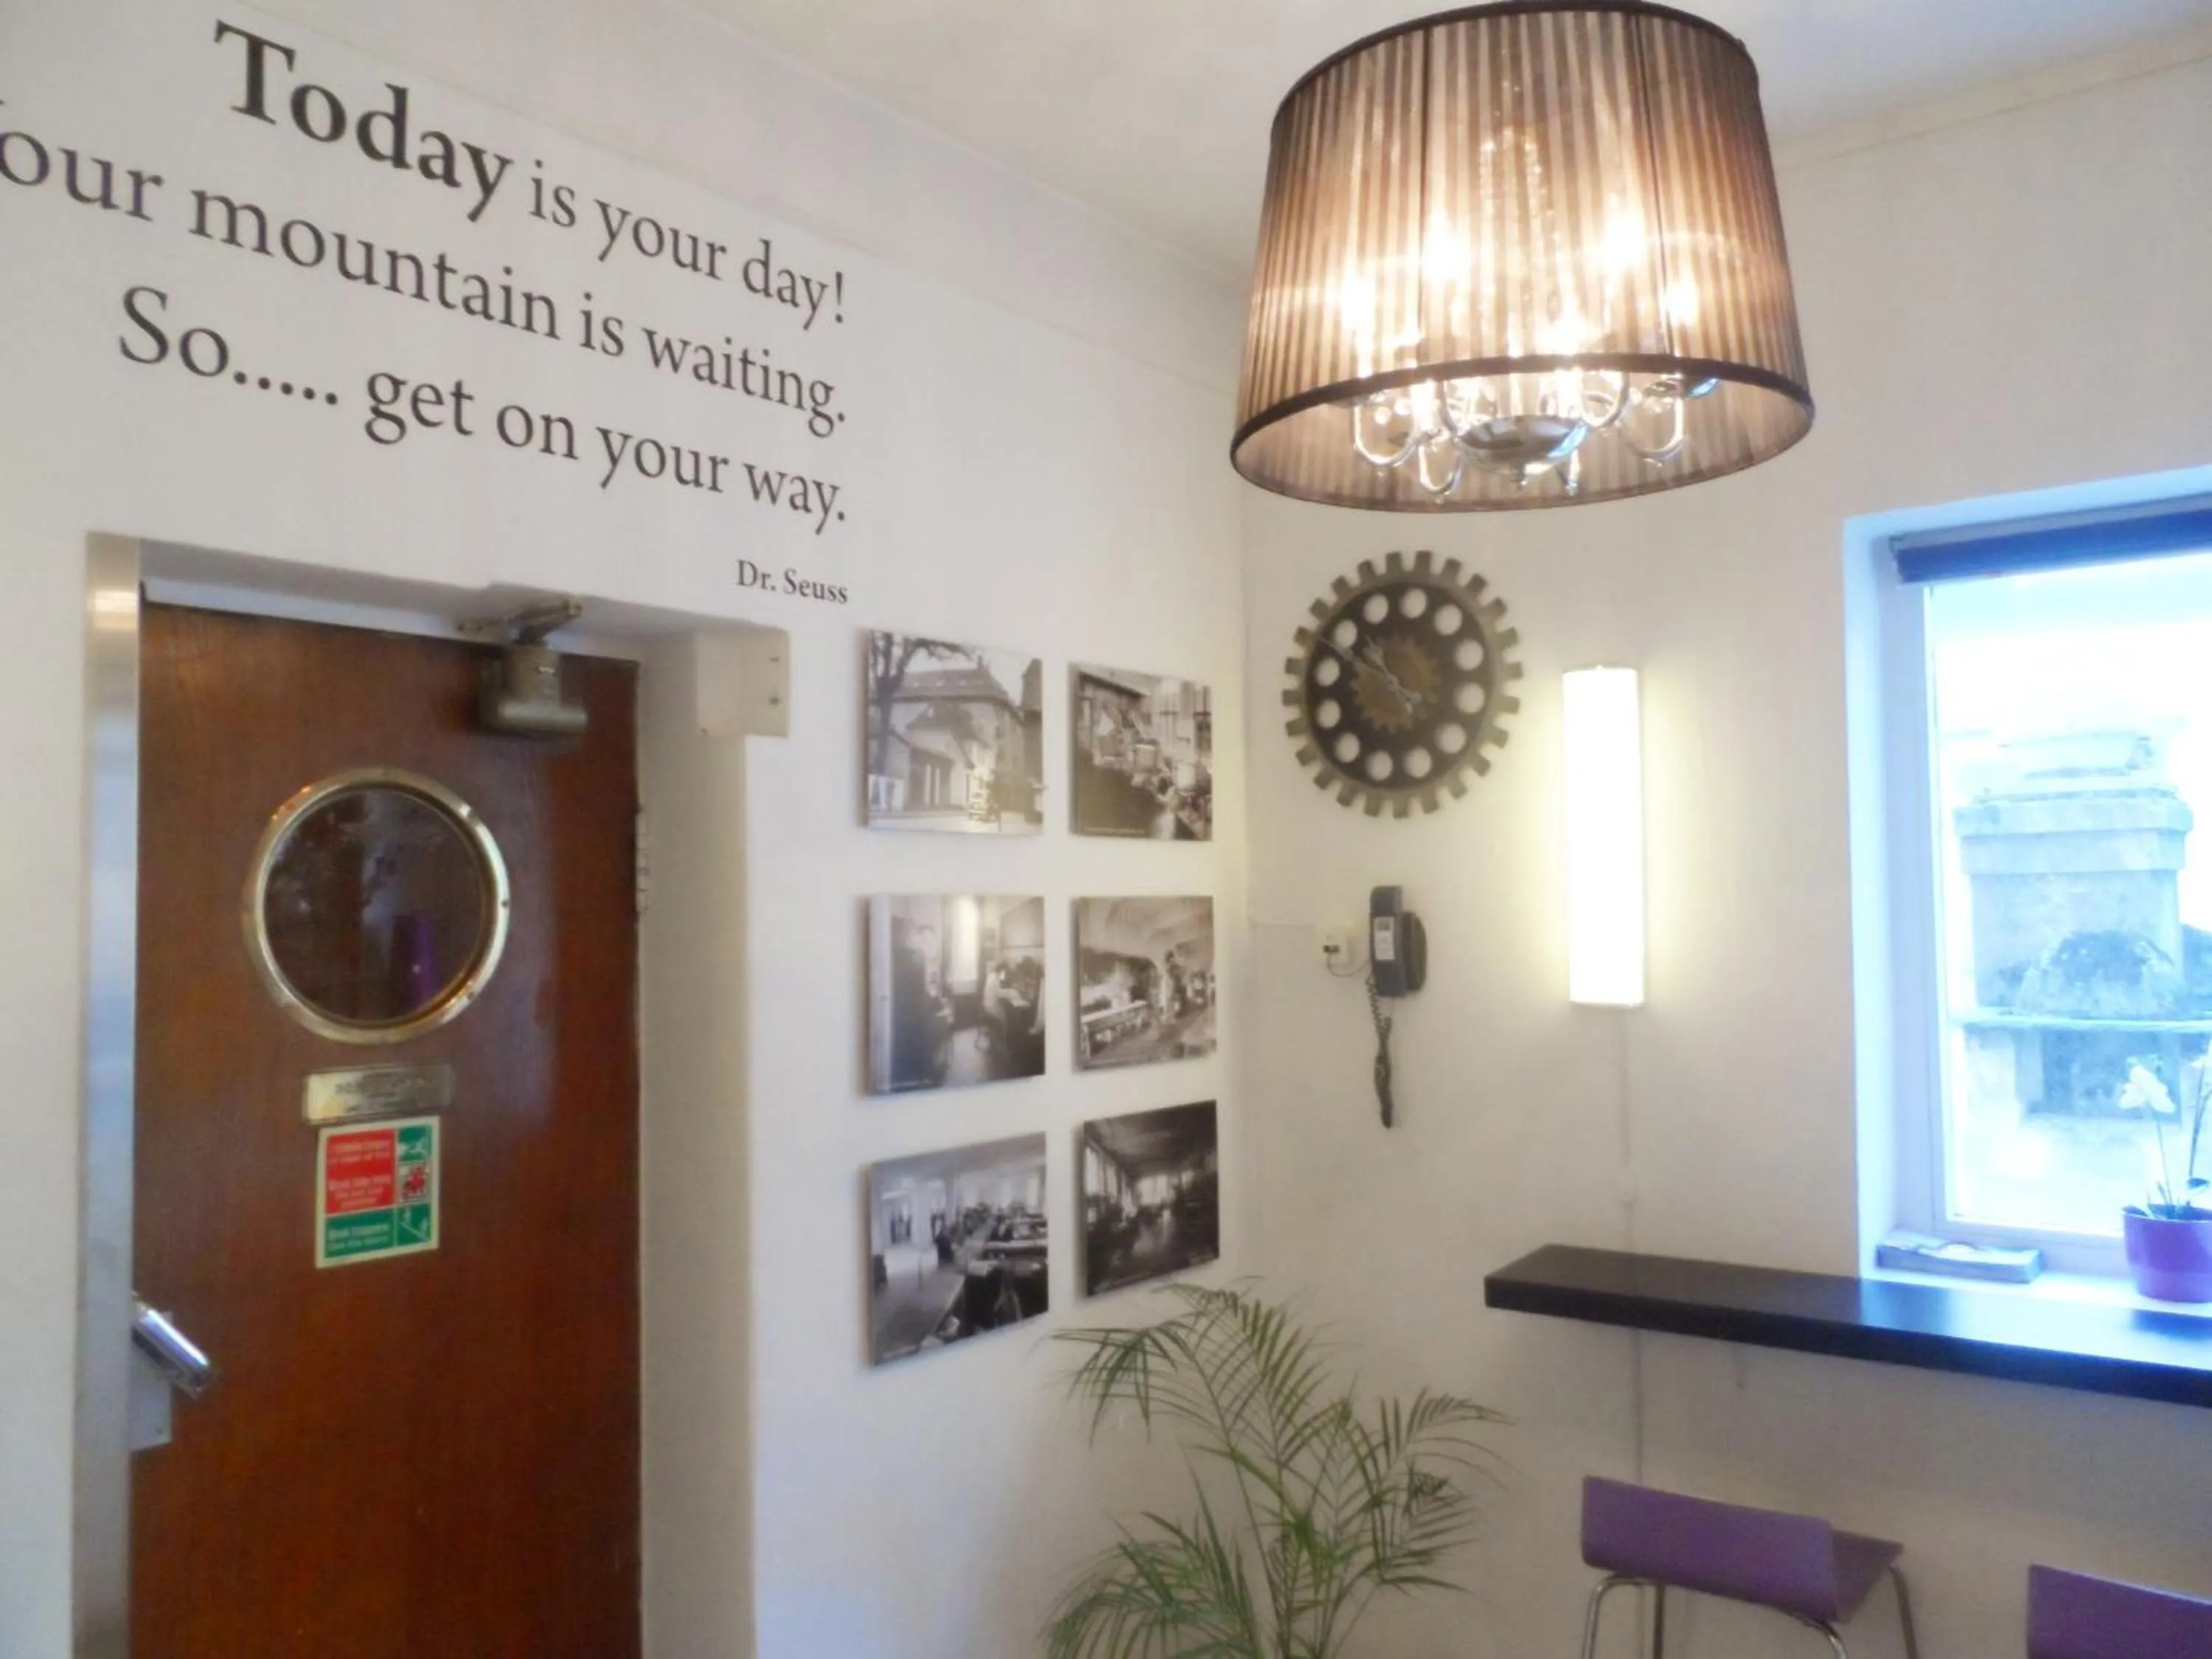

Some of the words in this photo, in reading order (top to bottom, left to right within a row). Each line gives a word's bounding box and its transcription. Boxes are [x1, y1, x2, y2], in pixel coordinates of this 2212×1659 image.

[0, 100, 164, 222] our
[188, 189, 560, 341] mountain
[579, 291, 625, 358] is
[641, 327, 846, 439] waiting.
[213, 19, 515, 223] Today
[529, 159, 577, 228] is
[594, 199, 728, 281] your
[742, 238, 845, 331] day!
[364, 372, 475, 446] get
[495, 405, 579, 461] on
[595, 426, 730, 494] your
[742, 462, 846, 536] way.
[737, 559, 776, 591] Dr.
[783, 567, 849, 605] Seuss
